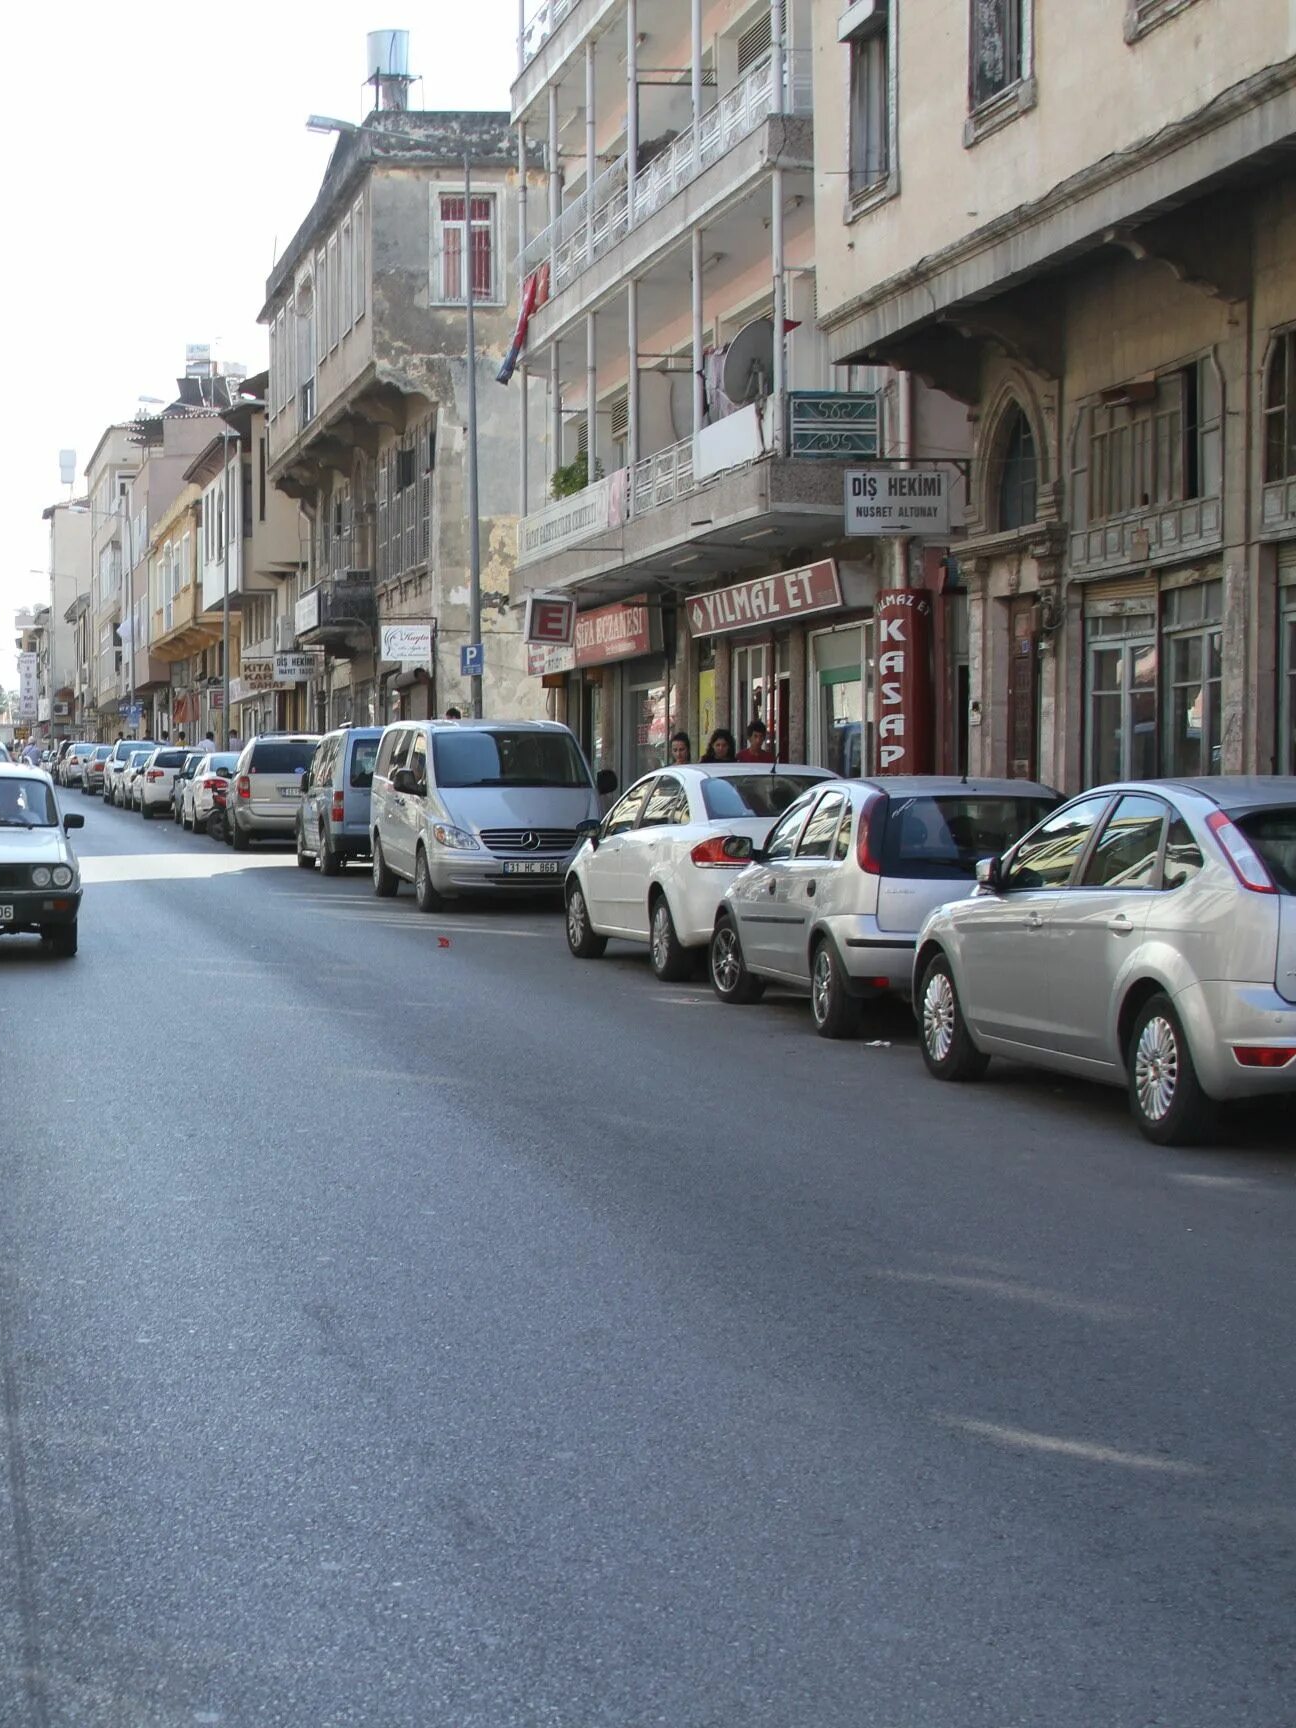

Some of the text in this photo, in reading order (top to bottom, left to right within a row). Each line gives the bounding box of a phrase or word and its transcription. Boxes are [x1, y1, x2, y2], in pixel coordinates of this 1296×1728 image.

[852, 473, 942, 501] DİŞ HEKİMİ
[856, 506, 939, 518] NUSRET ALTUNAY
[702, 570, 813, 629] YILMAZ ET
[466, 647, 477, 665] P
[878, 618, 907, 768] KASAP
[510, 863, 519, 872] 31
[525, 863, 534, 872] HC
